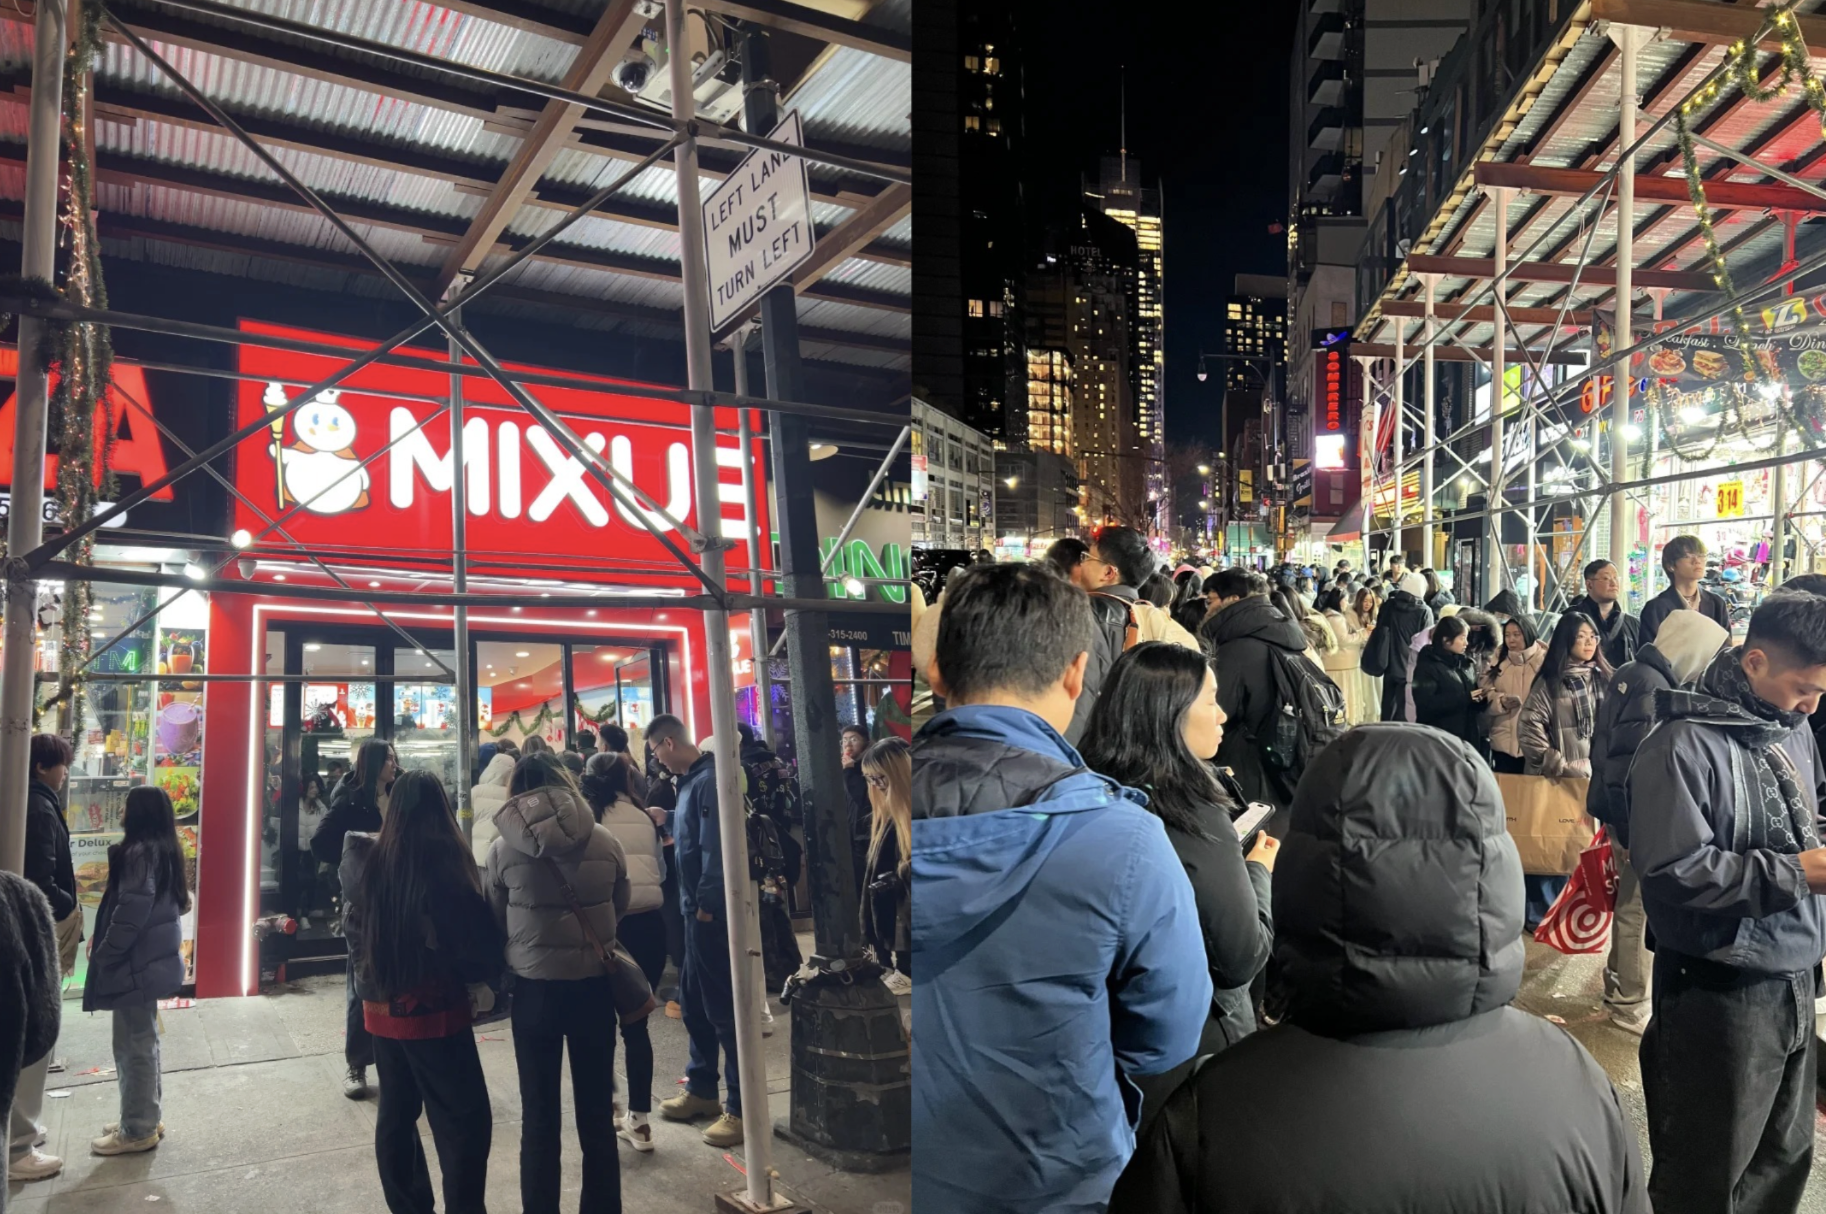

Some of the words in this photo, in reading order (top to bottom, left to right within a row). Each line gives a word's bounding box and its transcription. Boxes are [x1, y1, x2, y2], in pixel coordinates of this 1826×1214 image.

[710, 184, 743, 232] LEFT
[750, 137, 791, 193] LANE
[728, 192, 778, 259] MUST
[716, 260, 756, 306] TURN
[762, 220, 800, 271] LEFT
[1070, 245, 1102, 257] HOTEL
[1326, 351, 1340, 431] SOMBRERO
[389, 406, 761, 540] MIXUE
